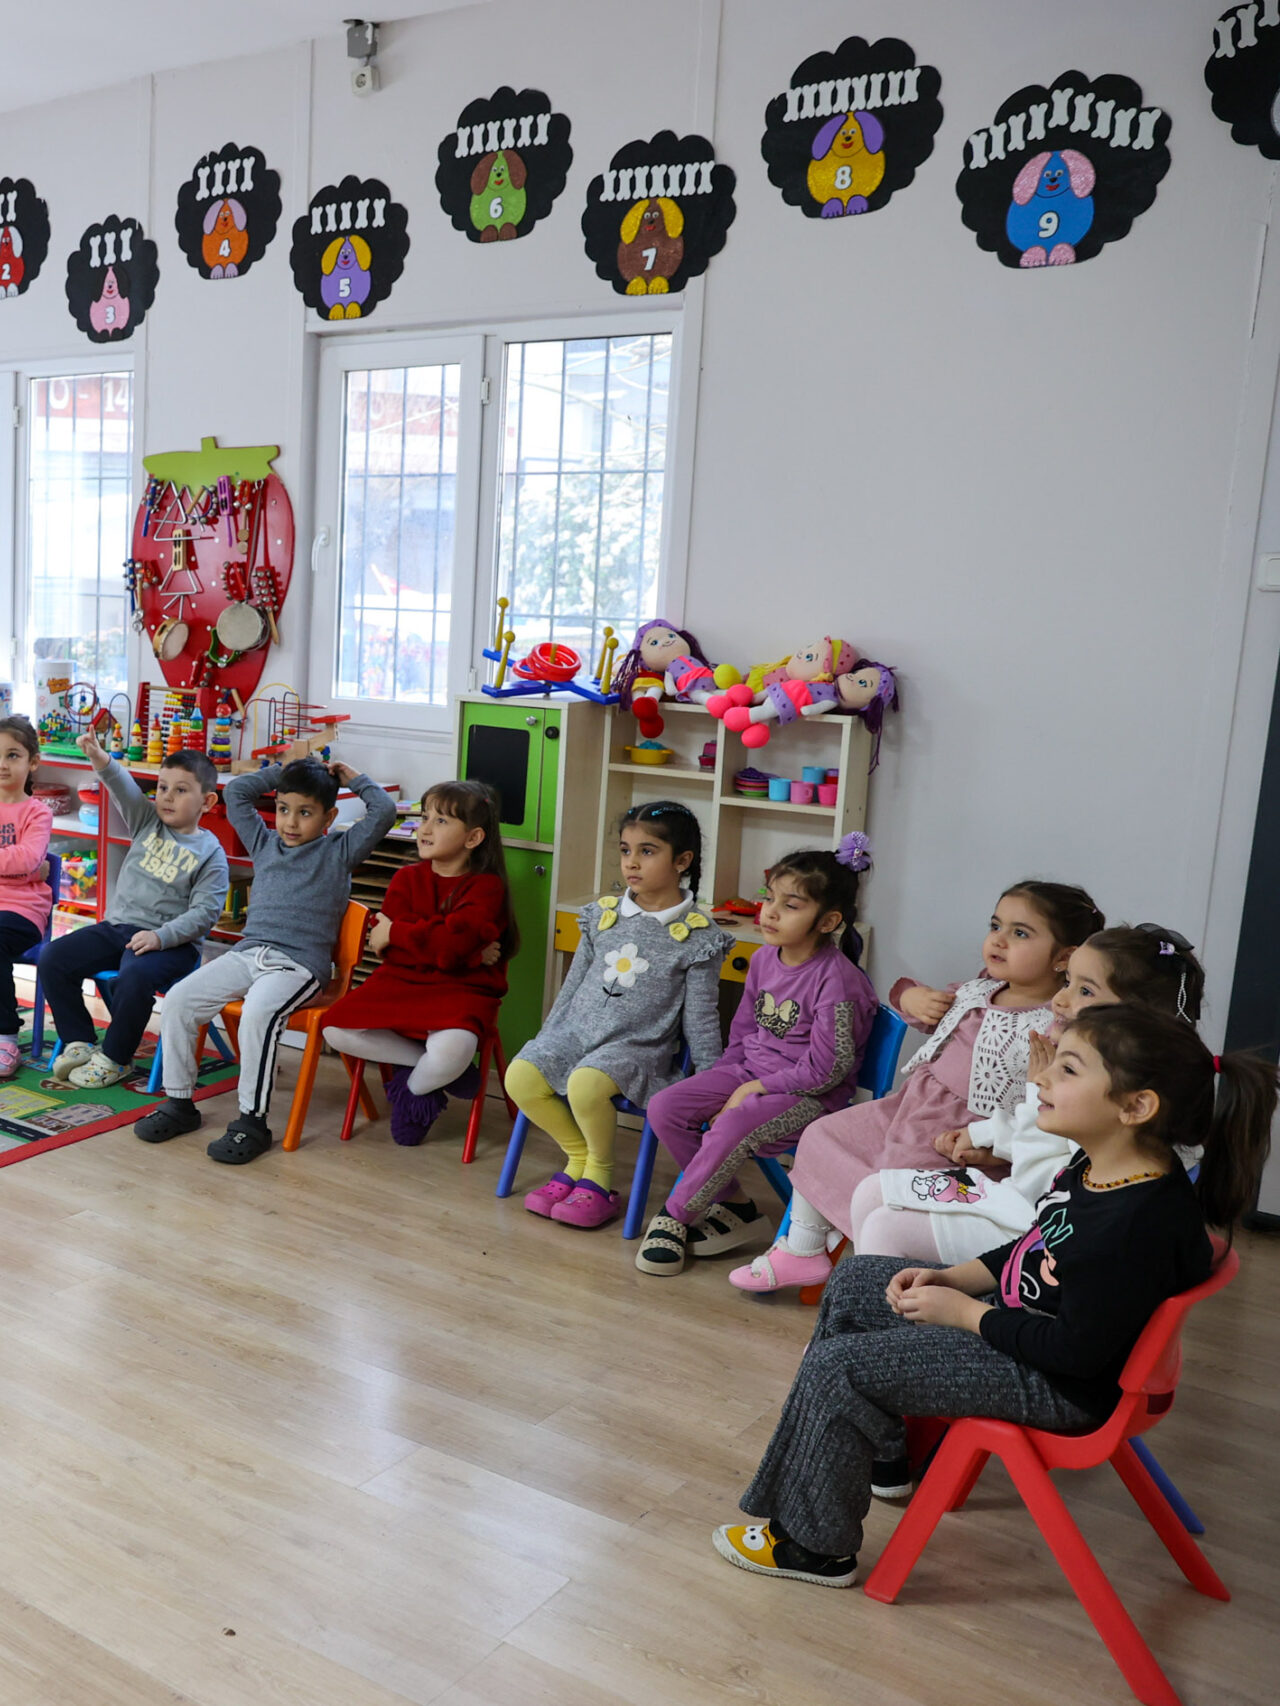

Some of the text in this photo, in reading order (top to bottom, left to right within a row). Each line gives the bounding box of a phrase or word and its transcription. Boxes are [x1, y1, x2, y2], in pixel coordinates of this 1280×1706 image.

[834, 165, 852, 190] 8
[489, 197, 503, 219] 6
[1038, 211, 1059, 238] 9
[218, 239, 231, 257] 4
[641, 247, 658, 271] 7
[1, 263, 11, 281] 2
[339, 277, 351, 298] 5
[105, 306, 116, 325] 3
